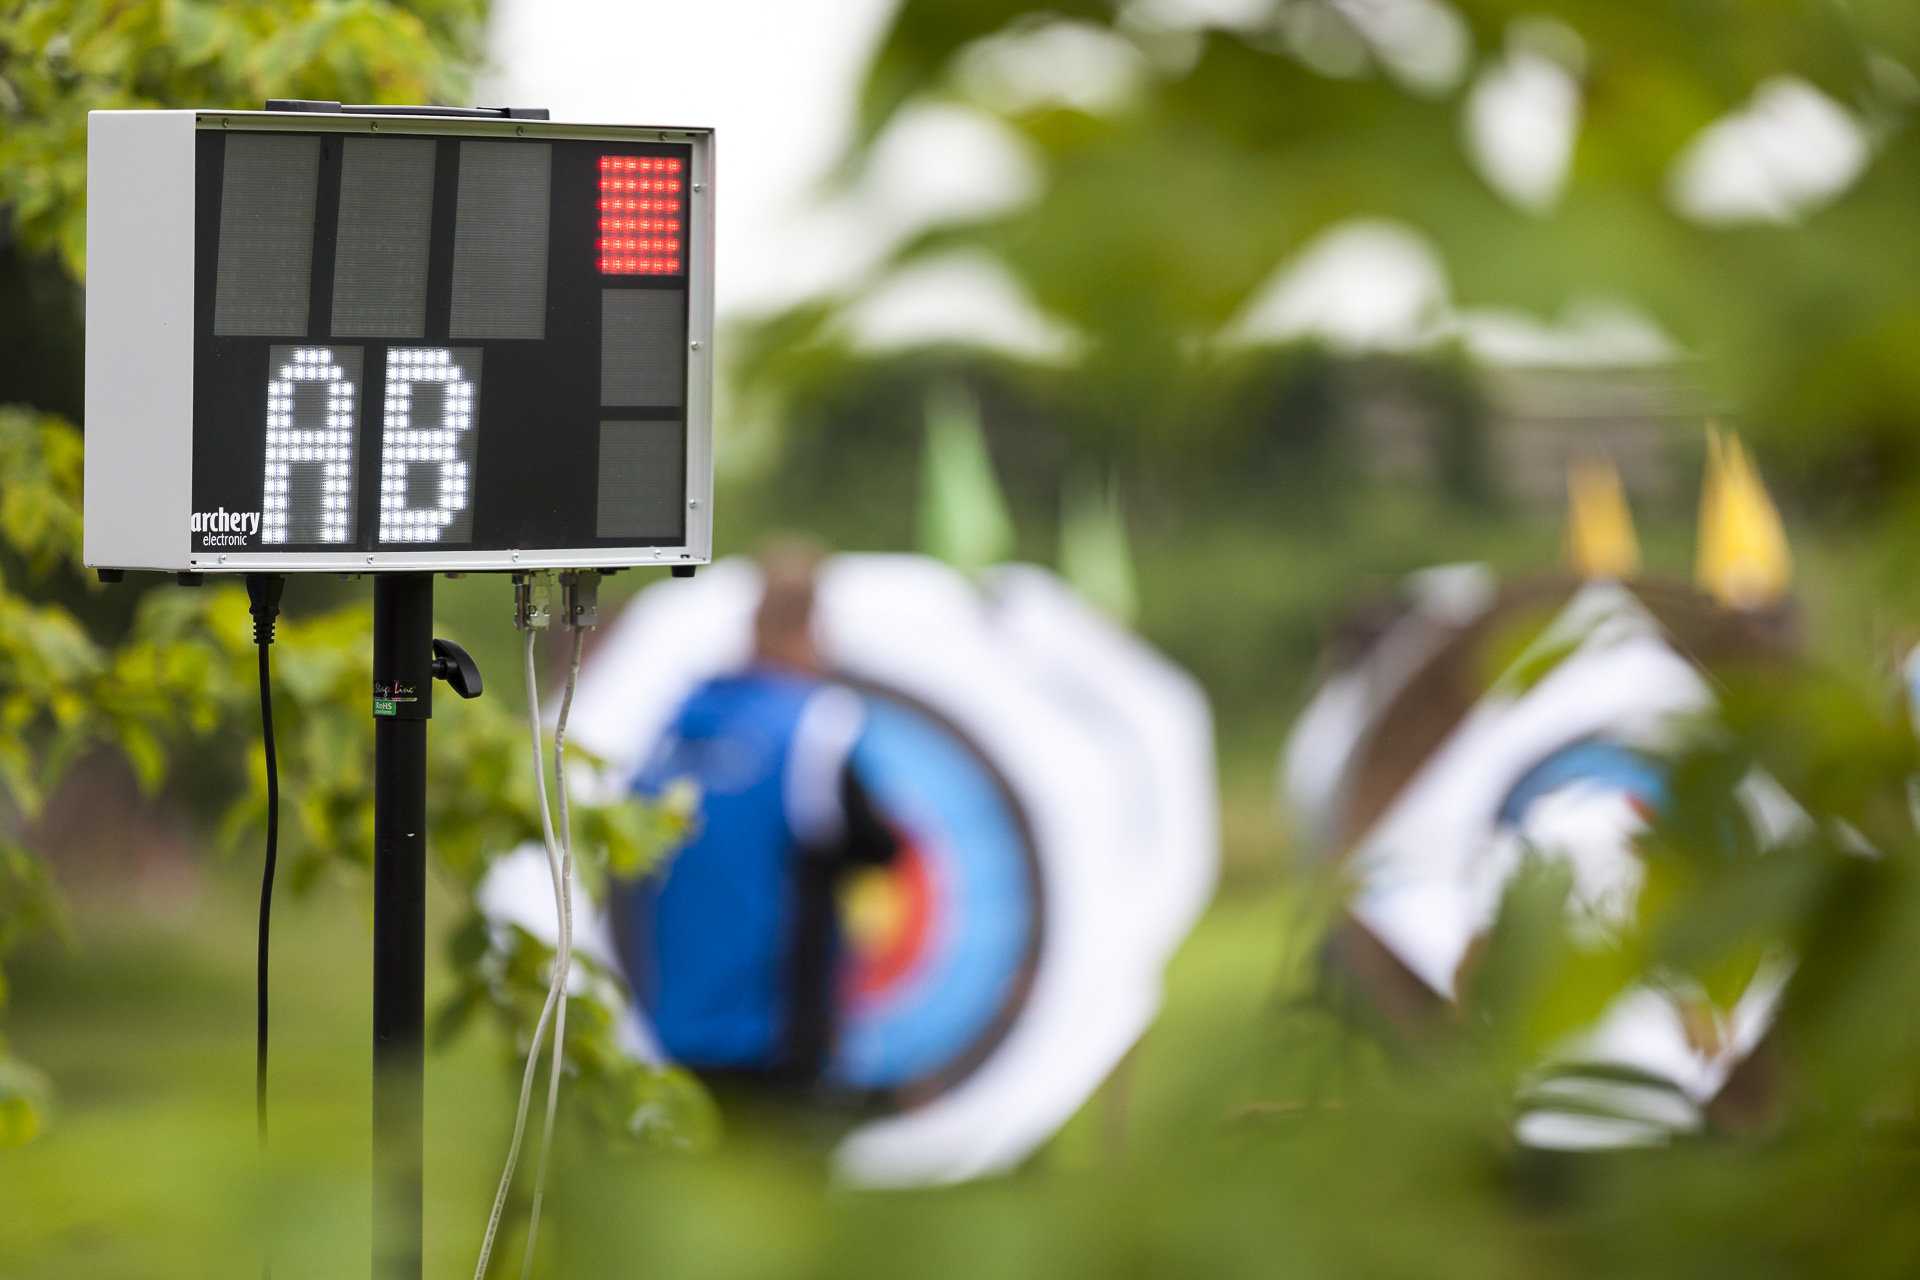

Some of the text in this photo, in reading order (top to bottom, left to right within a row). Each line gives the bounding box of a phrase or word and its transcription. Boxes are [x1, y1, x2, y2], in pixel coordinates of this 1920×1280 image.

[262, 348, 475, 544] AB
[191, 506, 260, 535] archery
[203, 532, 247, 546] electronic
[375, 702, 392, 710] RoHS
